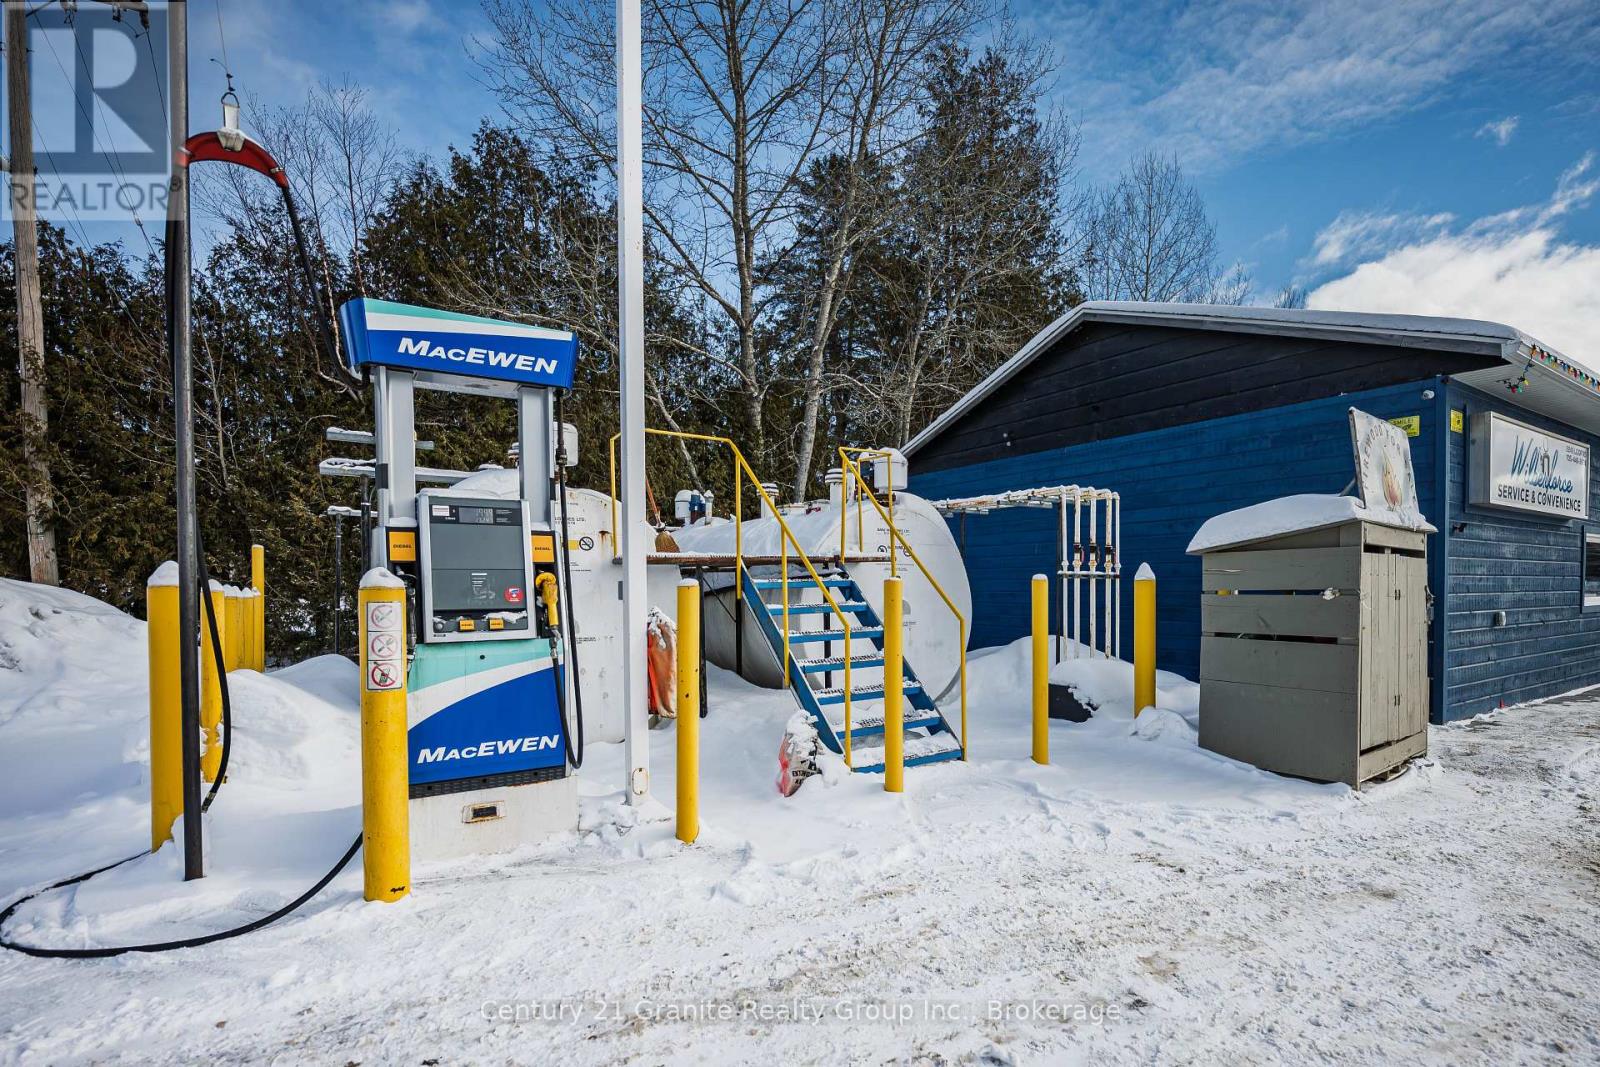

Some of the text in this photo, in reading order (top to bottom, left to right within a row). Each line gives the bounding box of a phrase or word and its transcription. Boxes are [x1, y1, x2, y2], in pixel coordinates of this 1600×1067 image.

[1497, 484, 1582, 512] SERVICE & CONVENIENCE
